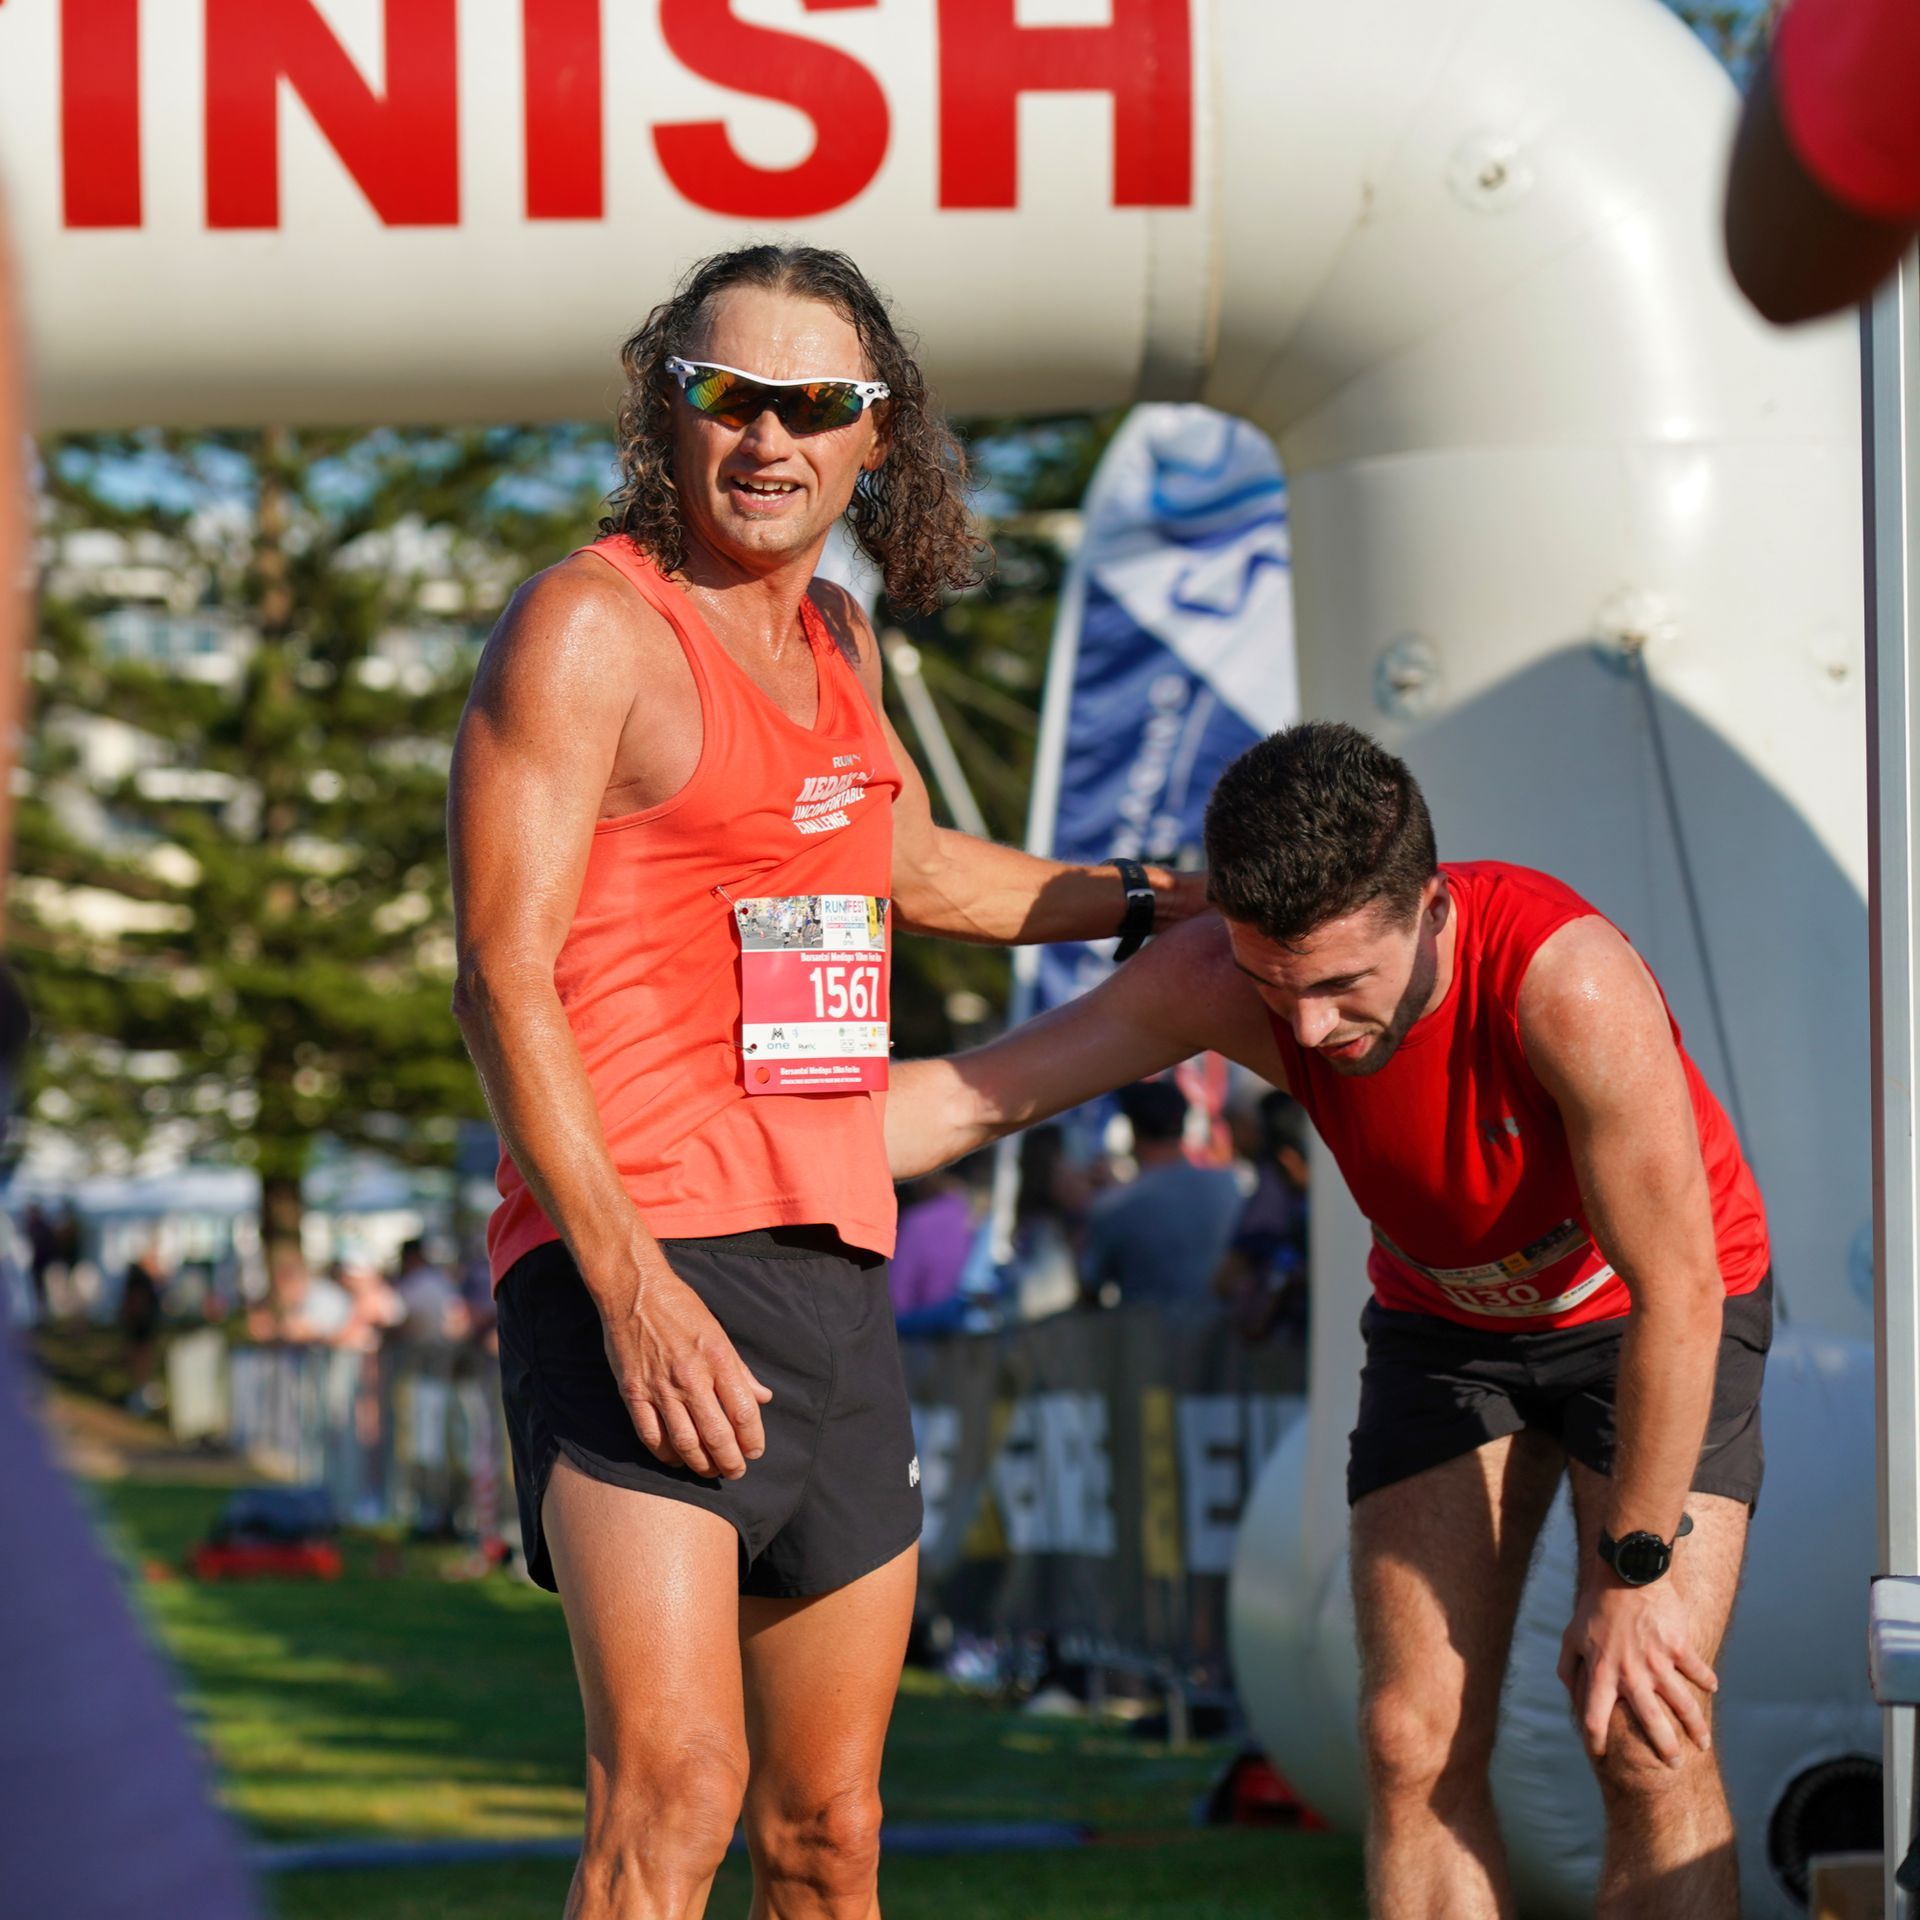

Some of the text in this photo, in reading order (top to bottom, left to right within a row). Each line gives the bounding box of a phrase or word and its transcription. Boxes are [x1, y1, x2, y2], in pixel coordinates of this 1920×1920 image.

[0, 0, 1194, 231] INISH
[791, 787, 866, 821] UNCOMFORTABLE
[793, 809, 851, 834] CHALLENGE
[809, 966, 880, 1018] 1567
[766, 1042, 790, 1050] one
